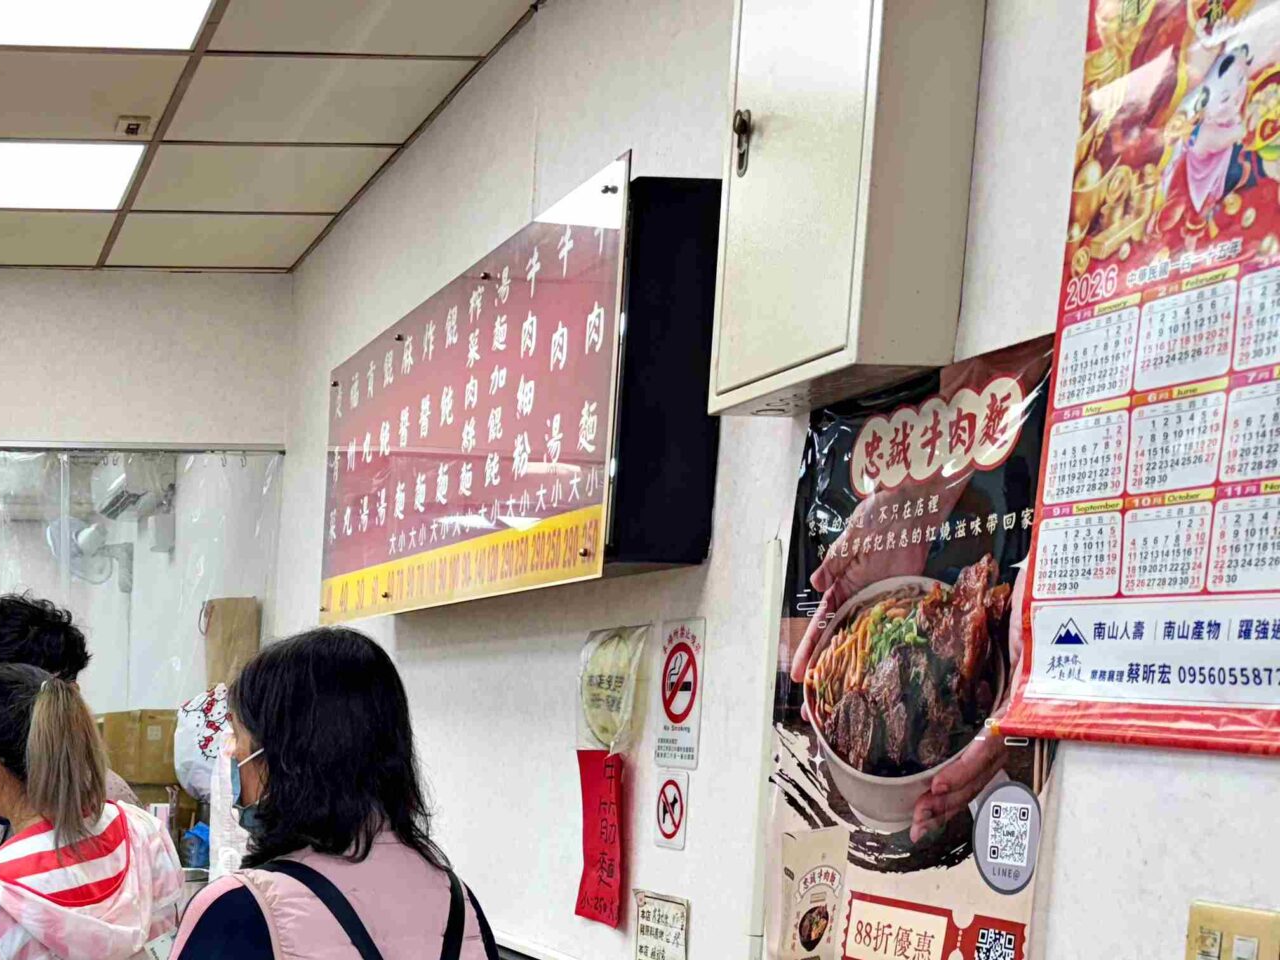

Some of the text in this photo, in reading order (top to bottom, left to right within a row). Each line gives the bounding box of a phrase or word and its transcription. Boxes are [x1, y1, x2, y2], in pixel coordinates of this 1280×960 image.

[1065, 265, 1118, 310] 2026
[1063, 410, 1080, 419] 5月
[861, 392, 1012, 478] 忠誠牛肉麵
[1167, 493, 1200, 502] October
[1225, 485, 1257, 496] 11月
[1053, 502, 1120, 516] 9月 September
[1093, 621, 1145, 641] 南山人壽
[1163, 620, 1221, 640] 南山產物
[1127, 663, 1171, 685] 蔡昕宏
